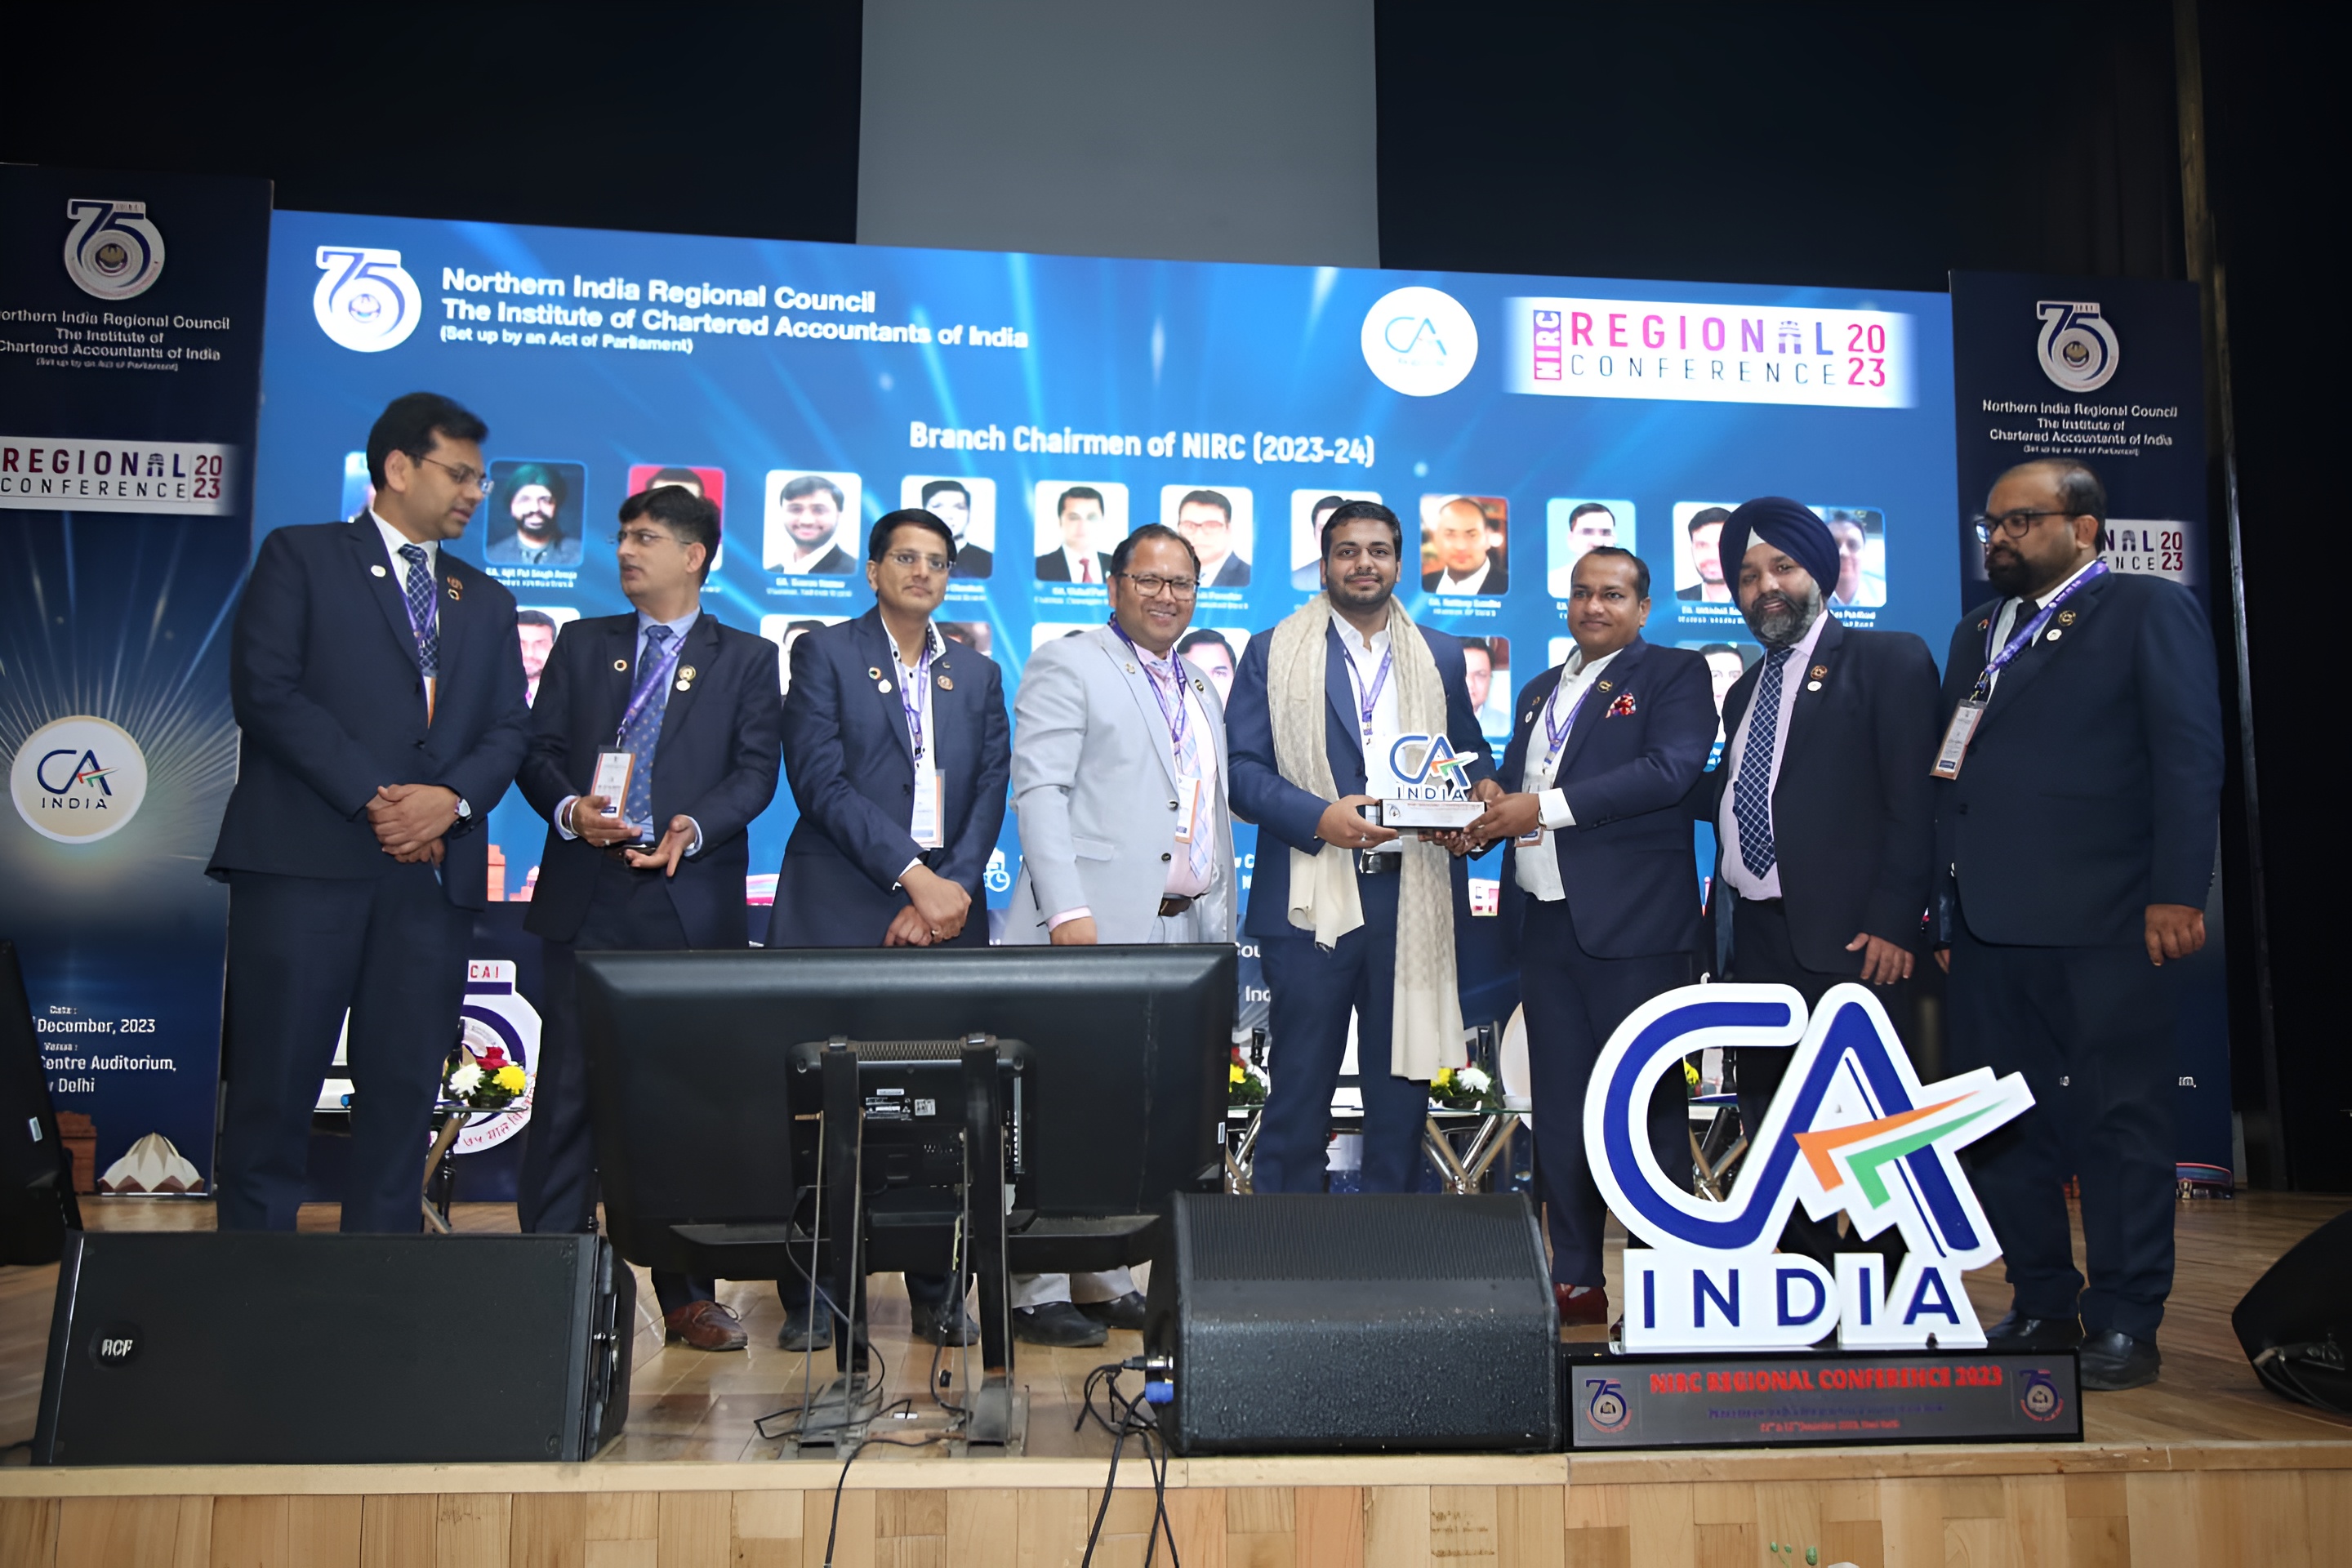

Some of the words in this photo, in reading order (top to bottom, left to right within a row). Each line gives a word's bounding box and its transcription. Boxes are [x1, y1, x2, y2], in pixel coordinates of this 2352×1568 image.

[442, 267, 565, 297] Northern
[573, 274, 640, 301] India
[648, 279, 766, 310] Regional
[773, 286, 875, 313] Council
[0, 309, 57, 323] orthern
[62, 310, 98, 325] India
[103, 313, 169, 328] Regional
[173, 315, 230, 330] Council
[441, 298, 491, 321] The
[498, 301, 603, 327] Institute
[610, 308, 636, 327] of
[642, 309, 768, 336] Chartered
[774, 316, 932, 344] Accountants
[938, 325, 964, 345] of
[969, 325, 1029, 349] India
[56, 327, 82, 340] The
[87, 330, 145, 343] Institute
[149, 332, 164, 344] of
[440, 326, 473, 342] (Set
[477, 330, 499, 345] up
[502, 330, 522, 346] by
[525, 332, 546, 343] an
[550, 332, 578, 346] Act
[581, 334, 598, 347] of
[602, 335, 693, 354] Parliament)
[1385, 317, 1447, 355] CA
[1570, 311, 1834, 357] REGIONAL
[1846, 323, 1886, 354] 20
[73, 343, 163, 359] Accountants
[167, 347, 181, 359] of
[186, 348, 221, 362] India
[1570, 354, 1837, 386] CONFERENCE
[1846, 357, 1886, 388] 23
[1982, 399, 2038, 414] Northern
[2041, 402, 2071, 415] India
[2074, 403, 2127, 418] Regional
[2132, 405, 2178, 418] Council
[2037, 417, 2060, 430] The
[2062, 419, 2110, 431] Institute
[2114, 421, 2125, 431] of
[909, 421, 1006, 452] Branch
[1013, 425, 1142, 457] Chairmen
[1147, 433, 1176, 458] of
[1183, 432, 1246, 461] NIRC
[1253, 430, 1375, 468] (2023-24)
[1989, 429, 2049, 443] Chartered
[2052, 431, 2127, 446] Accountants
[2129, 434, 2141, 445] of
[2144, 434, 2173, 447] India
[2, 448, 186, 478] REGIONAL
[194, 455, 223, 476] 20
[0, 477, 186, 499] CONFERENCE
[193, 478, 221, 499] 23
[2160, 531, 2183, 550] 20
[2161, 552, 2183, 571] 23
[37, 748, 113, 796] CA
[1389, 735, 1468, 787] CA
[41, 795, 108, 811] INDIA
[1397, 786, 1465, 801] INDIA
[37, 1018, 117, 1035] December,
[120, 1018, 156, 1033] 2023
[91, 1054, 177, 1072] Auditorium,
[58, 1076, 96, 1093] Delhi
[1603, 1000, 1981, 1258] CA
[1642, 1267, 1961, 1330] INDIA
[1650, 1371, 1703, 1394] NIRC
[1707, 1370, 1815, 1392] REGIONAL
[1818, 1366, 1951, 1390] CONFERENCE
[1955, 1365, 2004, 1387] 2023
